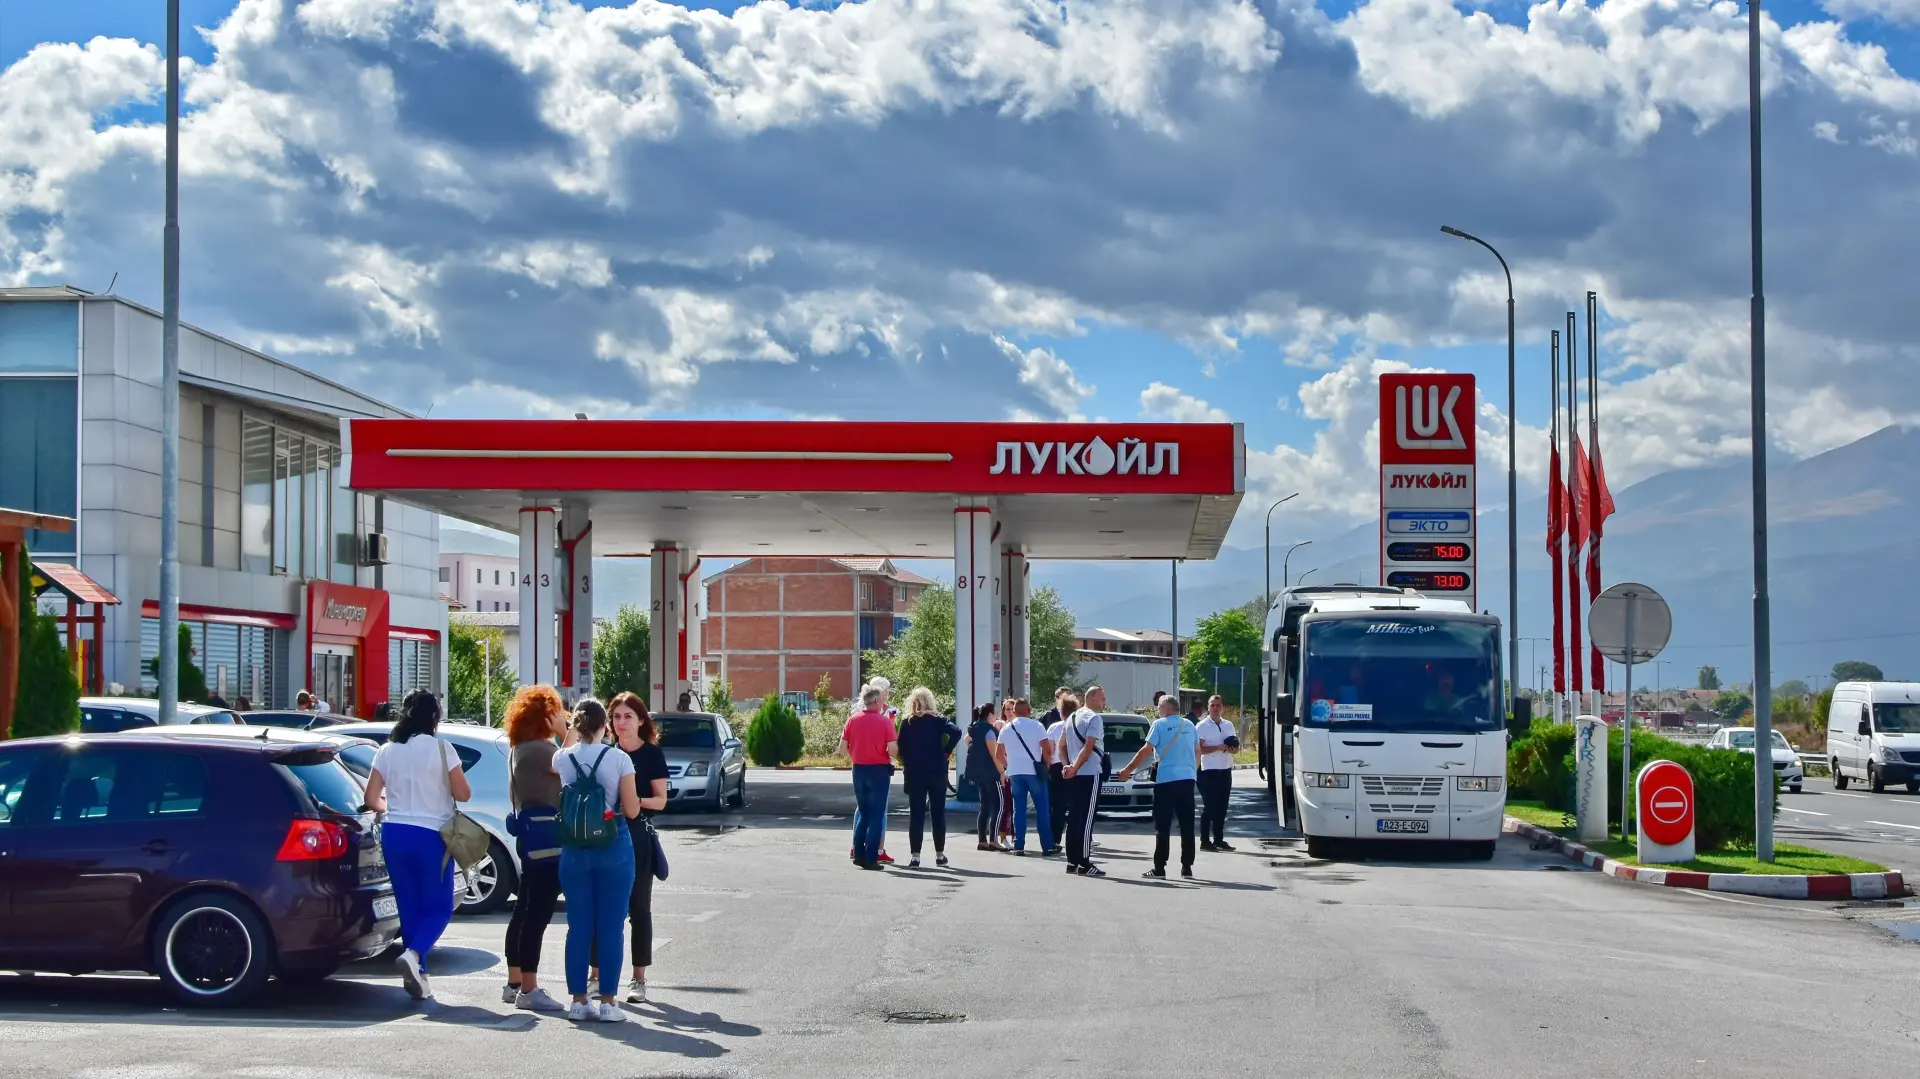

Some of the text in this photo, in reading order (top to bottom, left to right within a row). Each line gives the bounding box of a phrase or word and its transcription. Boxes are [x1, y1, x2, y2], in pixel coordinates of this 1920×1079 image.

[990, 435, 1179, 475] ЛУКОЙЛ
[1390, 472, 1467, 488] ЛУКОЙЛ
[1408, 521, 1449, 531] ЭКТО
[1434, 546, 1463, 558] 75.00
[522, 574, 531, 587] 4
[540, 574, 549, 587] 3
[582, 575, 589, 593] 3
[958, 576, 967, 588] 8
[978, 576, 986, 589] 7
[1434, 576, 1463, 588] 73.00
[653, 601, 660, 611] 2
[669, 602, 674, 611] 1
[1014, 606, 1021, 615] 5
[1366, 623, 1417, 633] Milkus
[1580, 727, 1592, 760] AIR
[1384, 822, 1426, 830] A23-E-094
